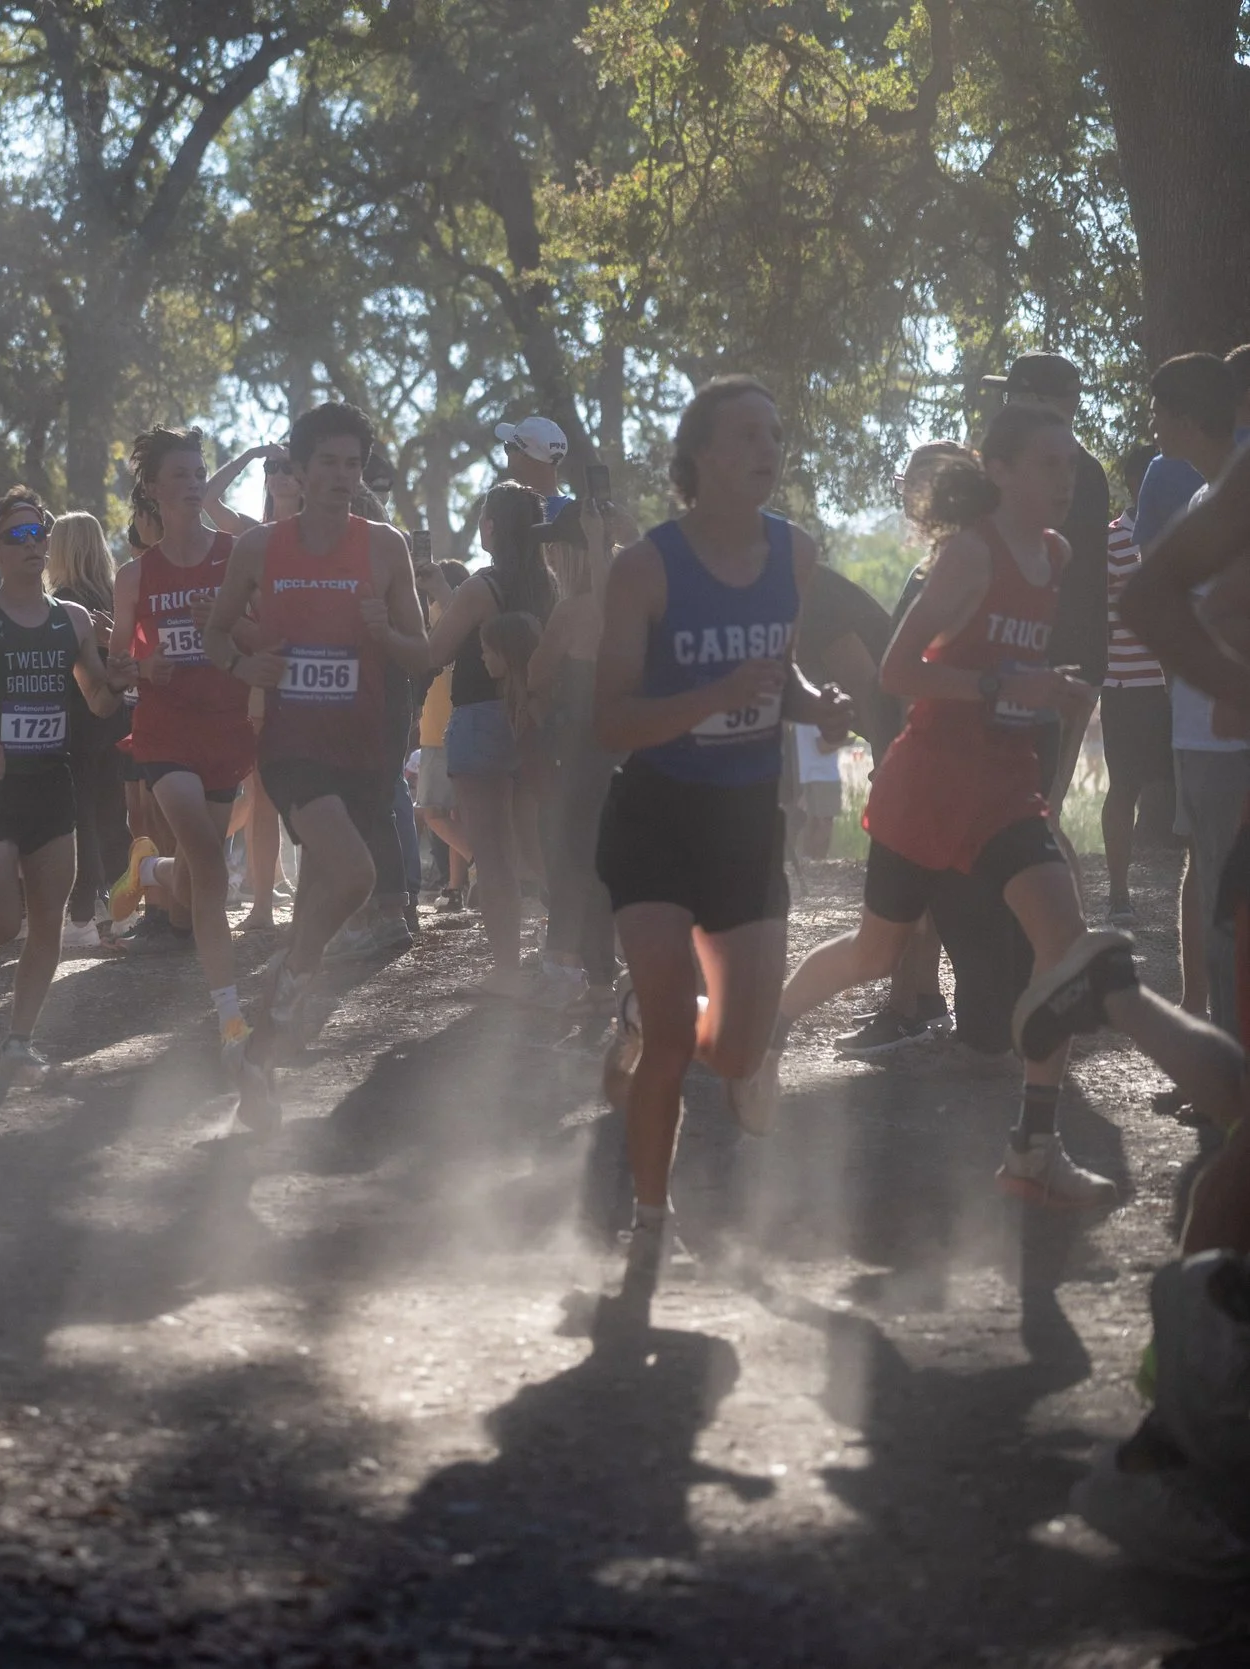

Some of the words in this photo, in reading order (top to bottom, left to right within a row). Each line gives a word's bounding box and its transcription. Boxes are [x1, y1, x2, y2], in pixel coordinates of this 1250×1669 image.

[273, 578, 359, 594] MCCLATCHY
[4, 650, 66, 671] TWELVE
[6, 674, 65, 694] BRIDGES
[287, 663, 350, 688] 1056
[10, 717, 62, 739] 1727
